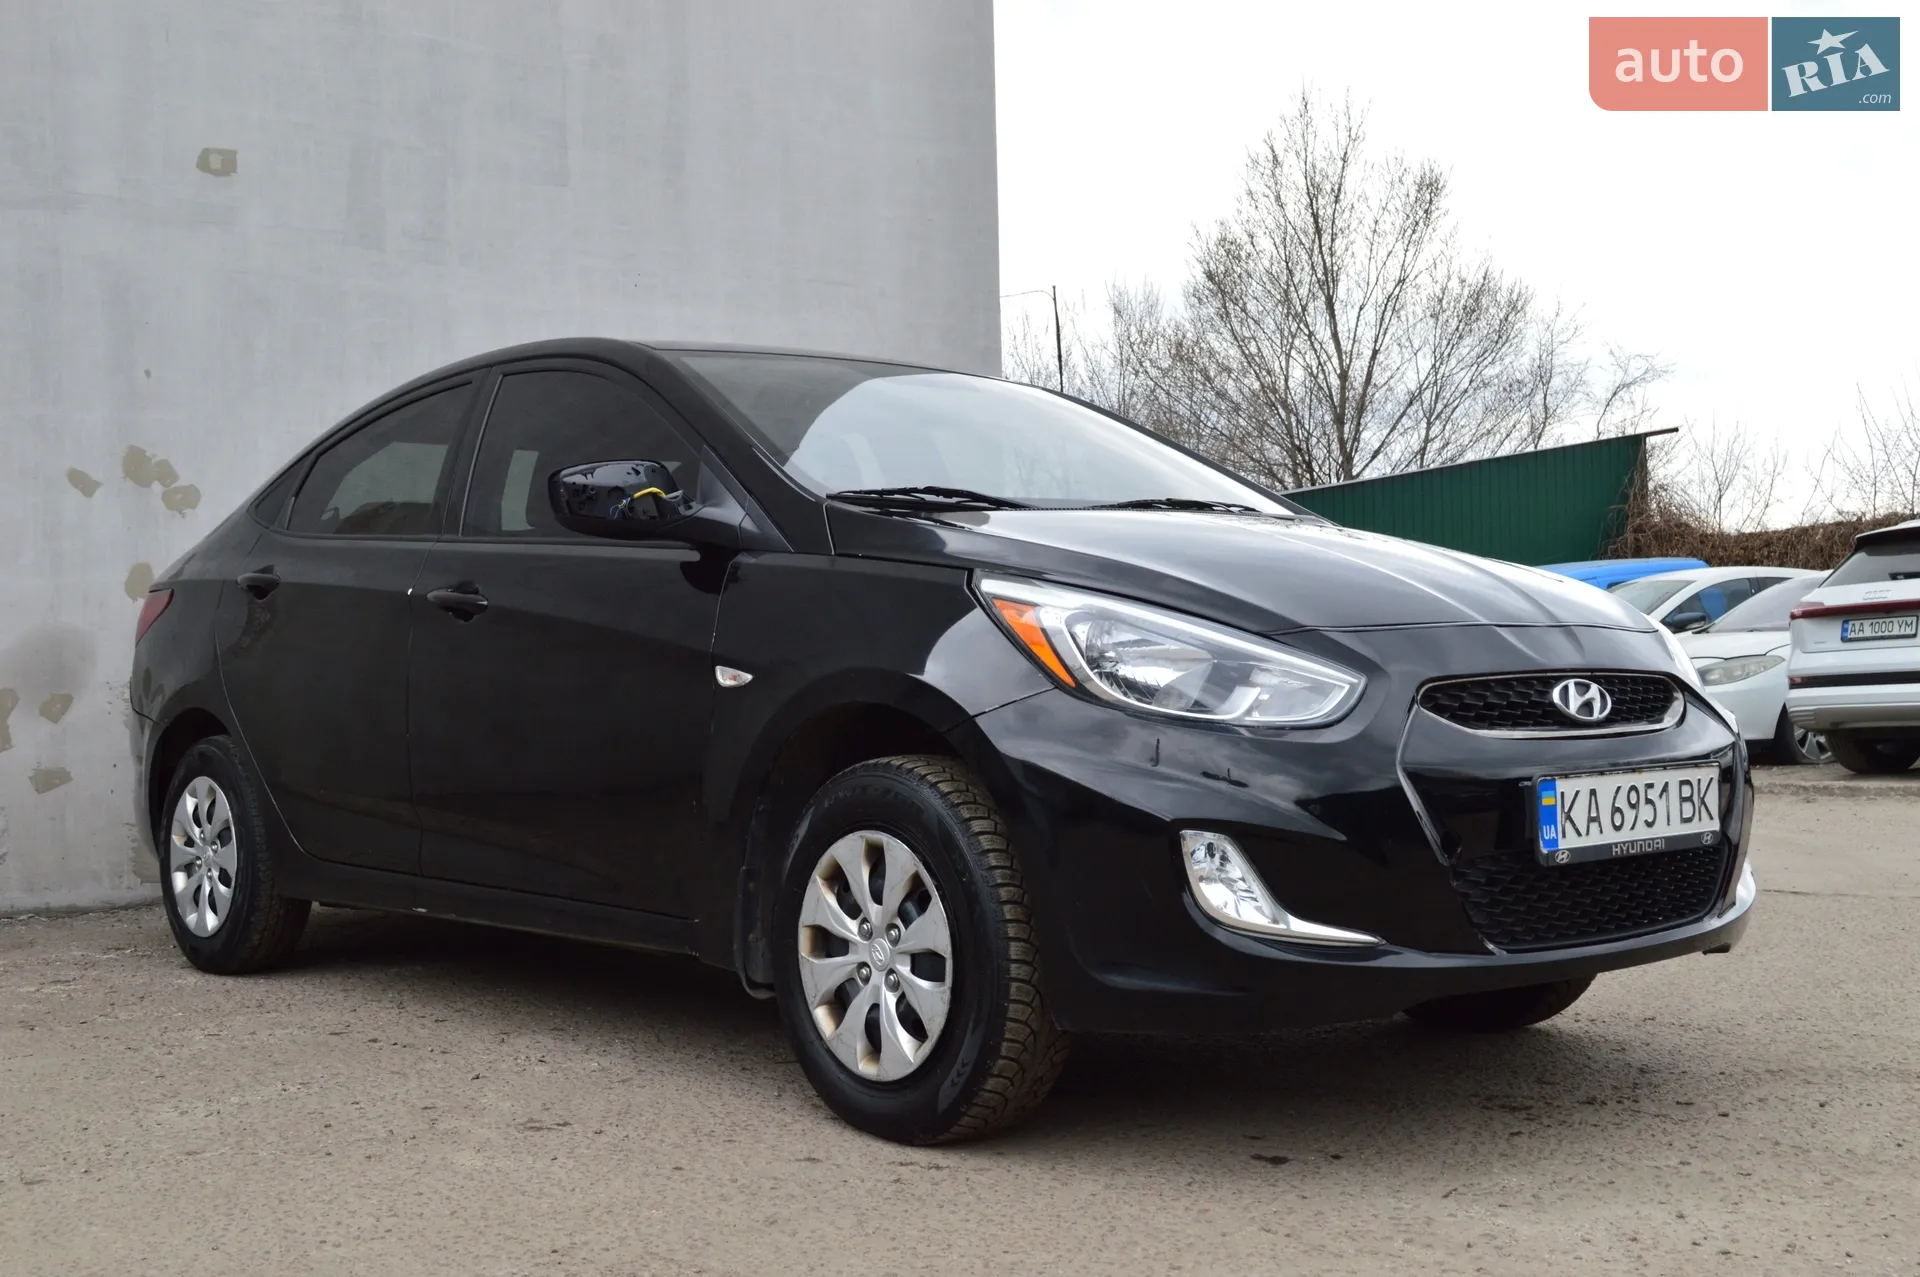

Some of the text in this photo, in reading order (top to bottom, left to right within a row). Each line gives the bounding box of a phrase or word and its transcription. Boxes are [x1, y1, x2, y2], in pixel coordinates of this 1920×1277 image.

[1849, 623, 1865, 636] AA
[1868, 620, 1894, 634] 1000
[1897, 619, 1914, 632] YM
[1560, 777, 1714, 839] KA 6951 BK
[1543, 826, 1557, 840] UA
[1612, 838, 1665, 856] HYUNDAI
